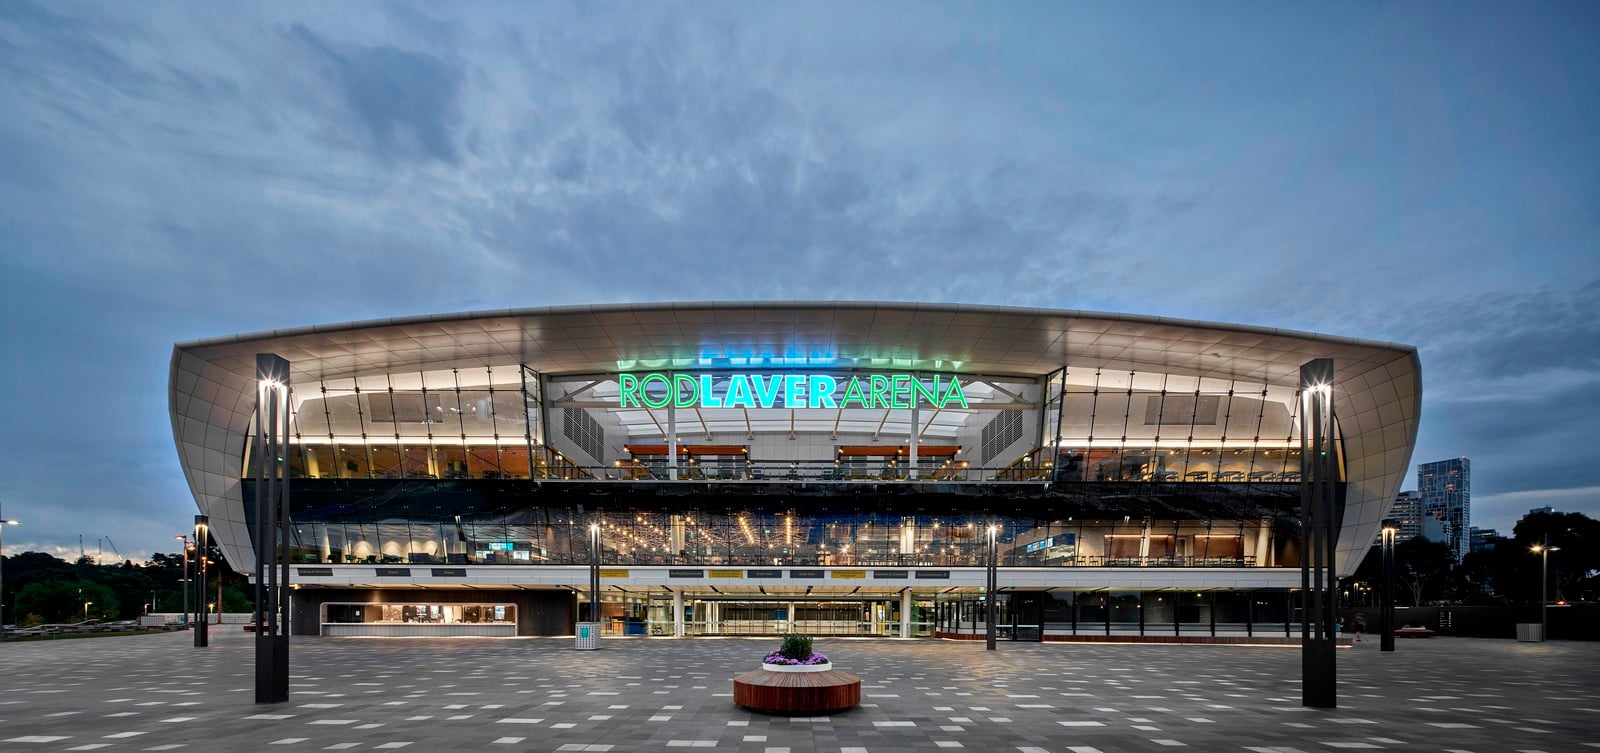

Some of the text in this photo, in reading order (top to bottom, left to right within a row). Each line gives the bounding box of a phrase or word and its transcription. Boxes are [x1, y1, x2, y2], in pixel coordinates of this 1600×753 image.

[619, 374, 968, 408] ROD LAVER ARENA
